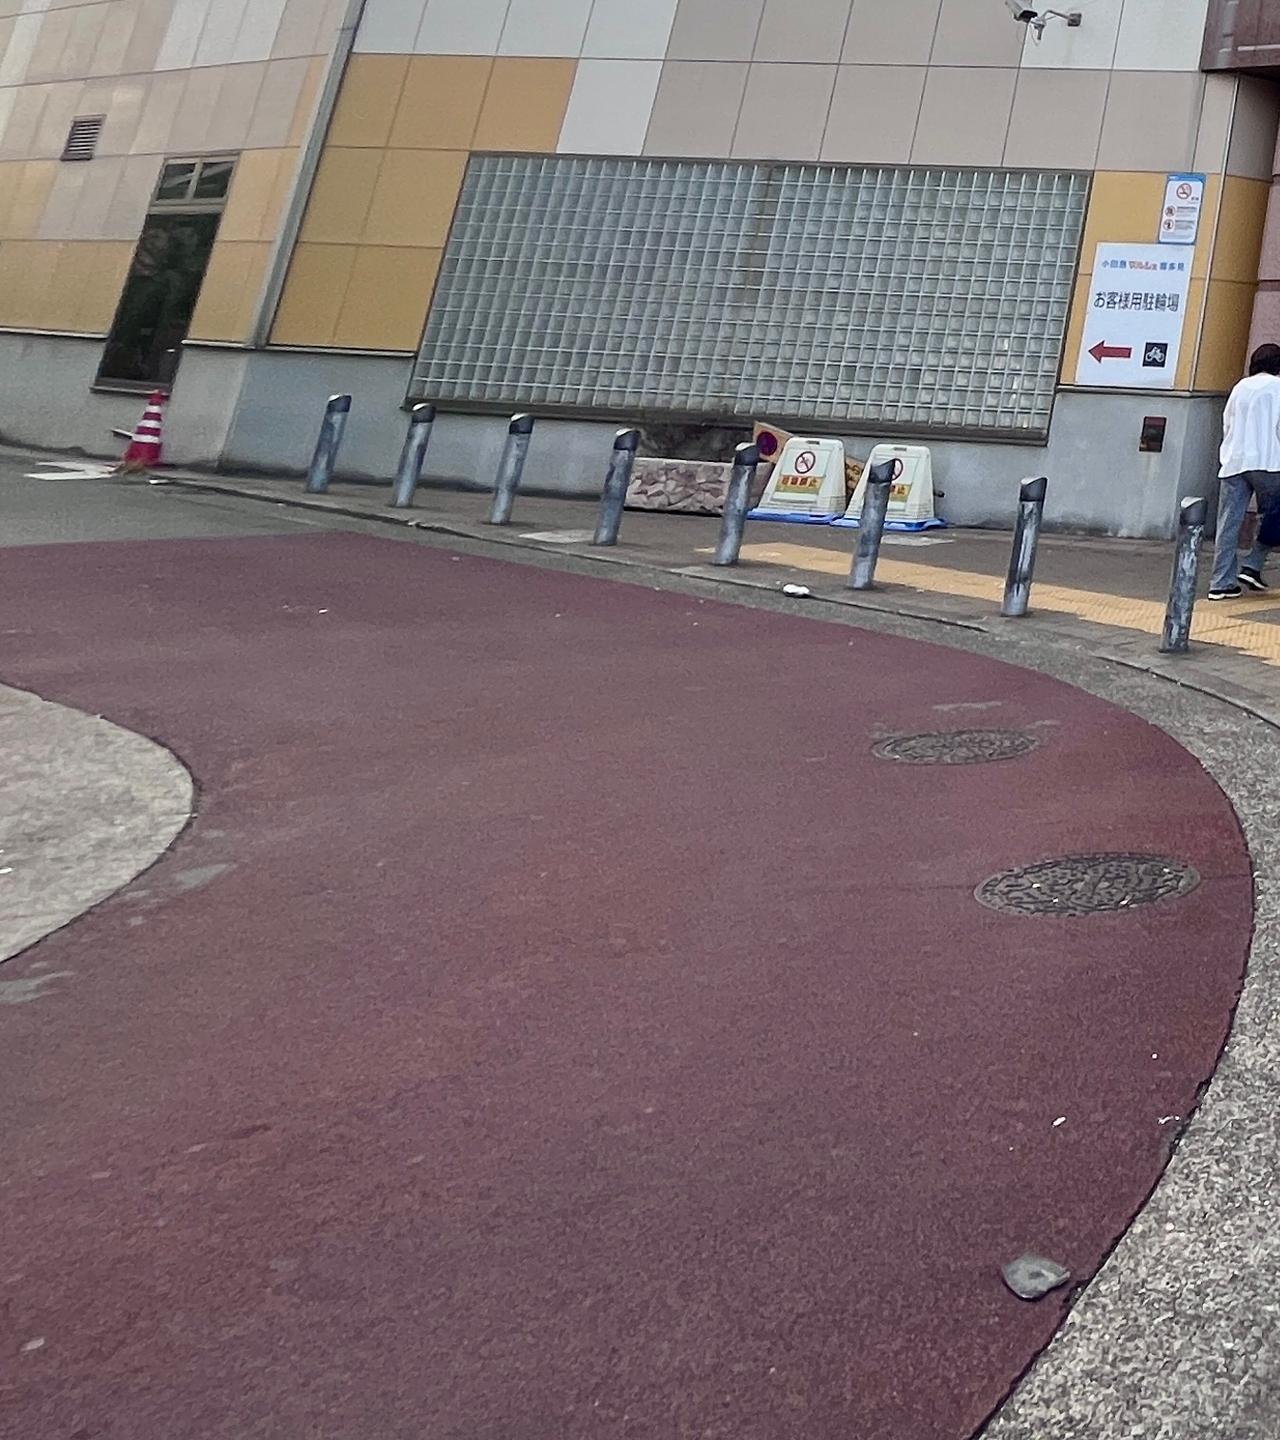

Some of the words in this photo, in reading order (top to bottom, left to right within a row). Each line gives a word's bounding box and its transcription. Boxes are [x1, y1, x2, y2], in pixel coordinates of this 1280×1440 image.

[1093, 291, 1180, 312] お客様用駐輪場
